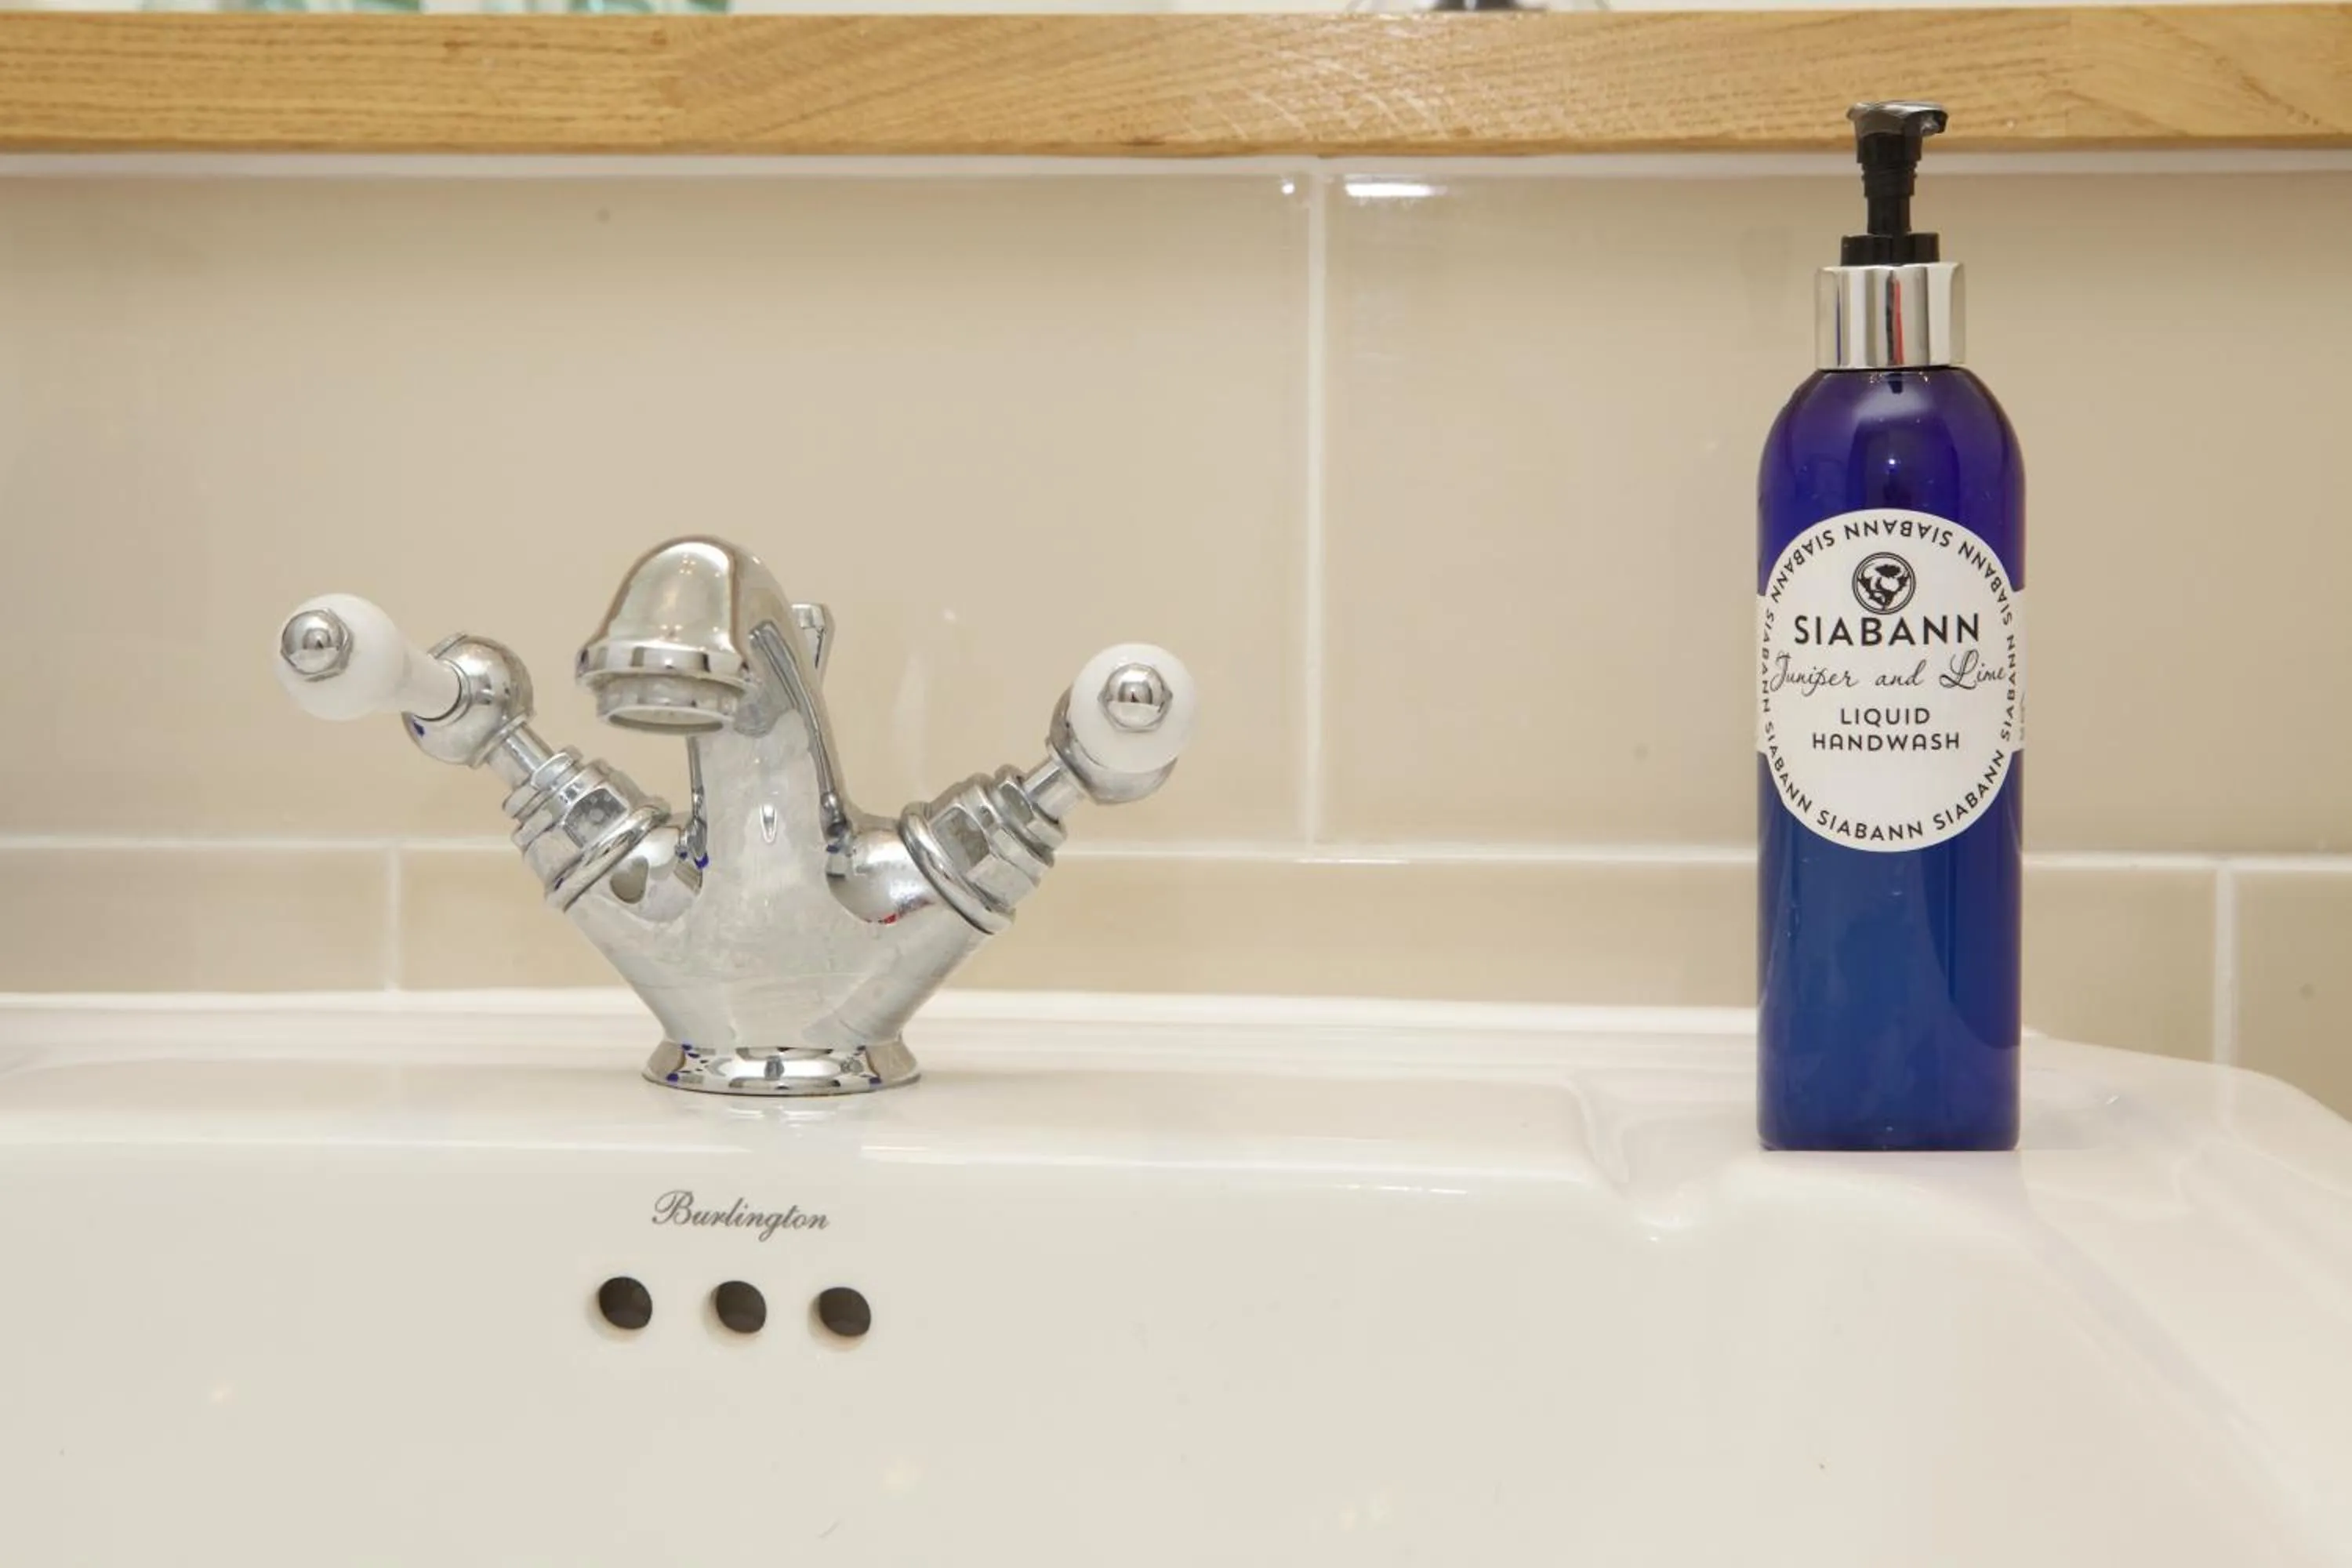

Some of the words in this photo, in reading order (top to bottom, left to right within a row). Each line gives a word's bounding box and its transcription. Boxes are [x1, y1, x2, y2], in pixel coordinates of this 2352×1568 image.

[1844, 519, 1953, 547] SIABANN
[1771, 530, 1835, 603] SIABANN
[1958, 540, 2013, 626] SIABANN
[1794, 613, 1980, 647] SIABANN
[1769, 650, 1860, 697] Juniper
[1875, 659, 1927, 686] and
[1939, 648, 2007, 690] Lime
[2000, 633, 2016, 742] SIABANN
[1812, 731, 1960, 751] HANDWASH
[1840, 707, 1931, 728] LIQUID
[1765, 720, 1813, 814] SIABANN
[1933, 750, 2004, 830] SIABANN
[1817, 810, 1924, 841] SIABANN
[652, 1189, 830, 1242] Burlington
